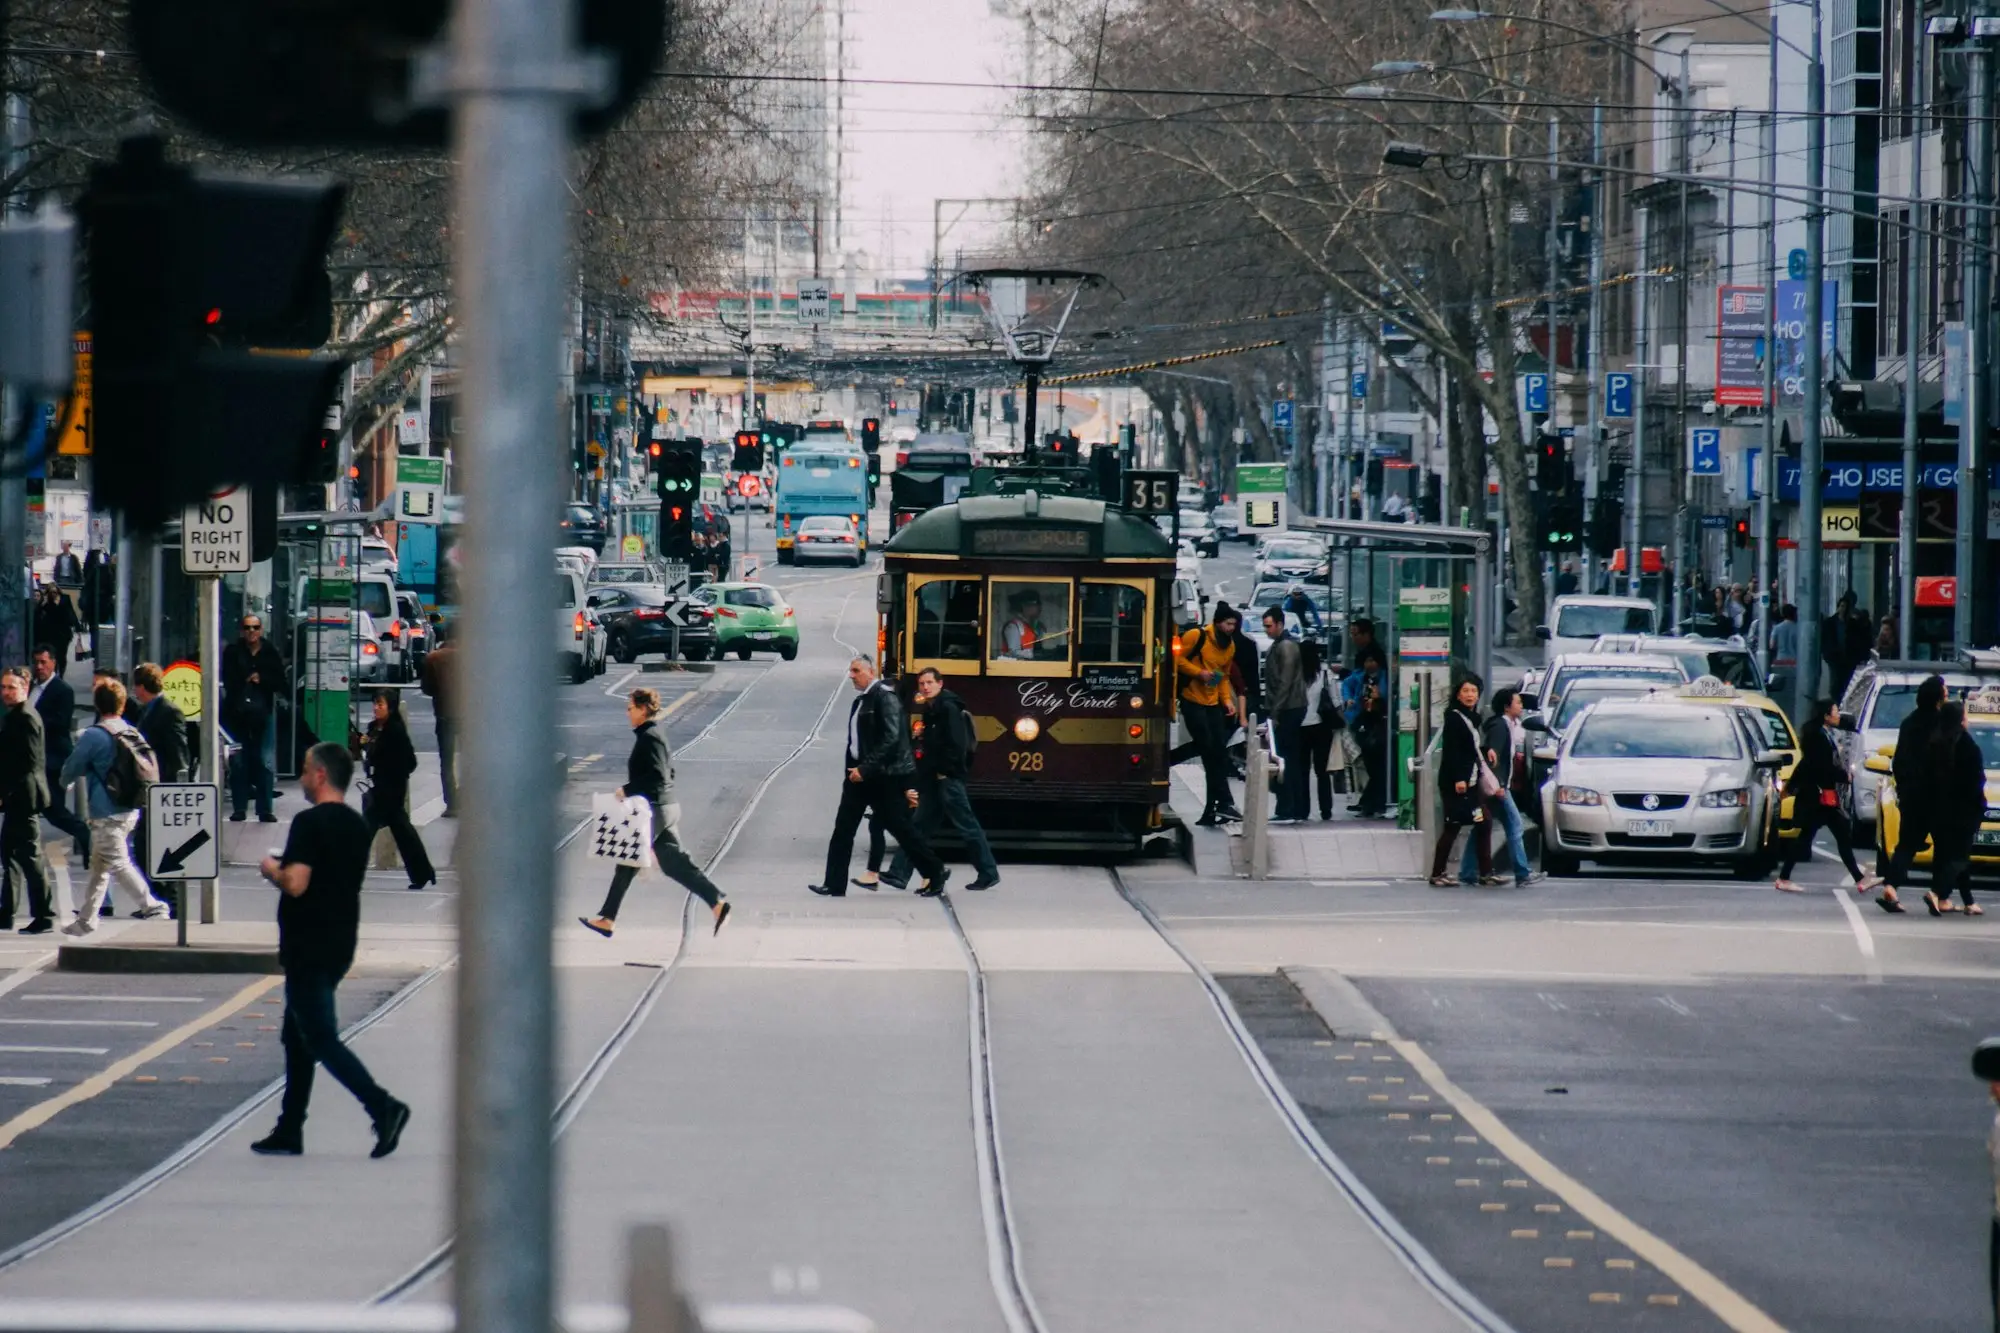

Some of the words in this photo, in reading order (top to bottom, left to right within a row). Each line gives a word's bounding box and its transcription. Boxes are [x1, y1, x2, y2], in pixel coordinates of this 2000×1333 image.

[801, 307, 828, 318] LANE
[1777, 320, 1833, 340] HOE
[1611, 376, 1628, 395] P
[1697, 432, 1715, 453] P
[1131, 479, 1167, 509] 35
[199, 504, 234, 524] NO
[190, 530, 243, 544] RIGHT
[192, 550, 241, 564] TURN
[1098, 676, 1128, 685] Flinders
[1130, 676, 1139, 685] St
[1700, 680, 1720, 689] TAXI
[1018, 680, 1064, 716] City
[1066, 682, 1121, 709] Circle
[1008, 752, 1044, 771] 928
[161, 793, 206, 807] KEEP
[162, 812, 204, 826] LEFT
